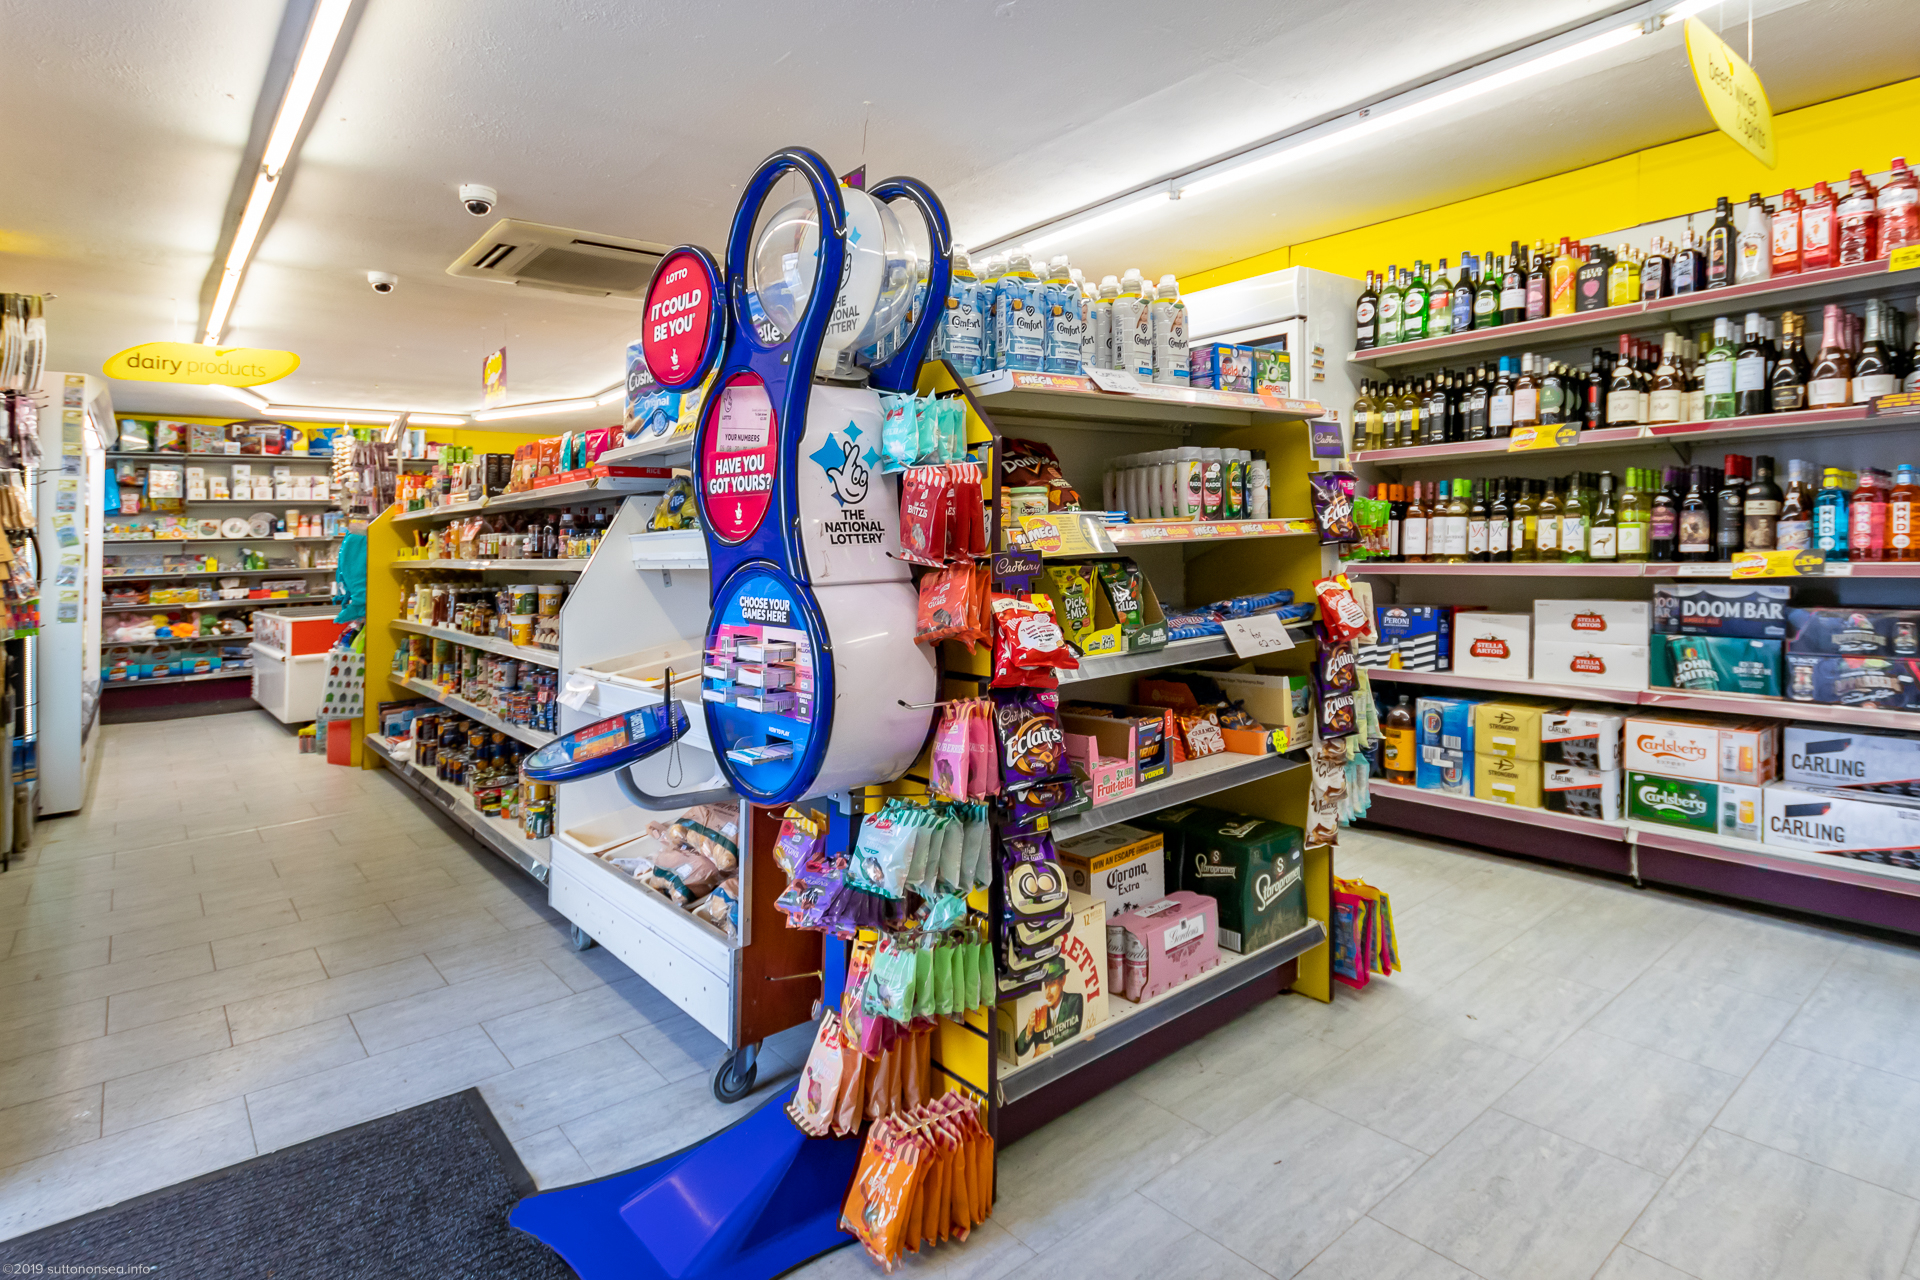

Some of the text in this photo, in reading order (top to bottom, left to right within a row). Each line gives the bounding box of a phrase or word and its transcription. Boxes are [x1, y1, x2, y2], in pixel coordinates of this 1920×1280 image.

[665, 267, 688, 285] LOTTO
[651, 288, 702, 322] IT COULD
[653, 315, 693, 343] BE YOU
[825, 319, 858, 335] OTTERY
[952, 315, 980, 330] Comfort
[1017, 316, 1043, 331] Comfort
[1057, 322, 1080, 336] Comfort
[127, 353, 267, 378] dairy products
[1222, 364, 1238, 376] Bold
[628, 371, 656, 392] Cushe
[1018, 375, 1053, 386] MEGA
[738, 434, 760, 442] NUMBERS
[715, 454, 765, 475] HAVE YOU
[709, 473, 771, 494] GOT YOURS?
[841, 510, 865, 520] THE
[1896, 504, 1907, 531] WKD
[825, 522, 885, 532] NATIONAL
[1028, 525, 1060, 542] MEGA
[1141, 527, 1168, 538] MEGA
[1193, 526, 1217, 536] MEGA
[1241, 524, 1263, 533] MEGA
[830, 533, 884, 544] LOTTERY
[1036, 538, 1060, 547] deals
[995, 557, 1041, 575] Cadbury
[739, 596, 790, 611] CHOOSE YOUR
[1065, 596, 1086, 611] Pick
[1682, 600, 1784, 619] DOOM BAR
[742, 609, 787, 623] GAMES HERE
[1071, 607, 1088, 619] Mix
[1384, 616, 1410, 626] PERONI
[1477, 641, 1503, 649] STELLA
[1326, 651, 1354, 681] Eclairs
[1678, 659, 1712, 674] JOHN
[1324, 695, 1353, 724] Eclairs
[1489, 723, 1519, 731] STRONGBOW
[1548, 725, 1571, 735] CARLING
[1006, 728, 1062, 767] Eclairs
[1637, 734, 1707, 760] Carlsberg
[1791, 753, 1865, 777] CARLING
[1144, 767, 1164, 780] YORKIE
[1488, 770, 1519, 779] STRONGBOW
[1551, 774, 1574, 784] CARLING
[1097, 777, 1133, 798] Fruit-tella
[1638, 785, 1707, 813] Carlsberg
[1771, 816, 1845, 843] CARLING
[1093, 848, 1135, 870] WIN AN ESCAPE
[1195, 853, 1236, 879] Staropramen
[1277, 857, 1284, 872] S
[1107, 863, 1148, 889] Corona
[1118, 882, 1139, 896] Extra
[1256, 864, 1301, 911] Staropramen
[1083, 913, 1090, 926] 12
[1169, 924, 1200, 945] Gordon's
[1060, 932, 1100, 1003] RETTI
[1044, 1014, 1079, 1040] L'AUTENTICA
